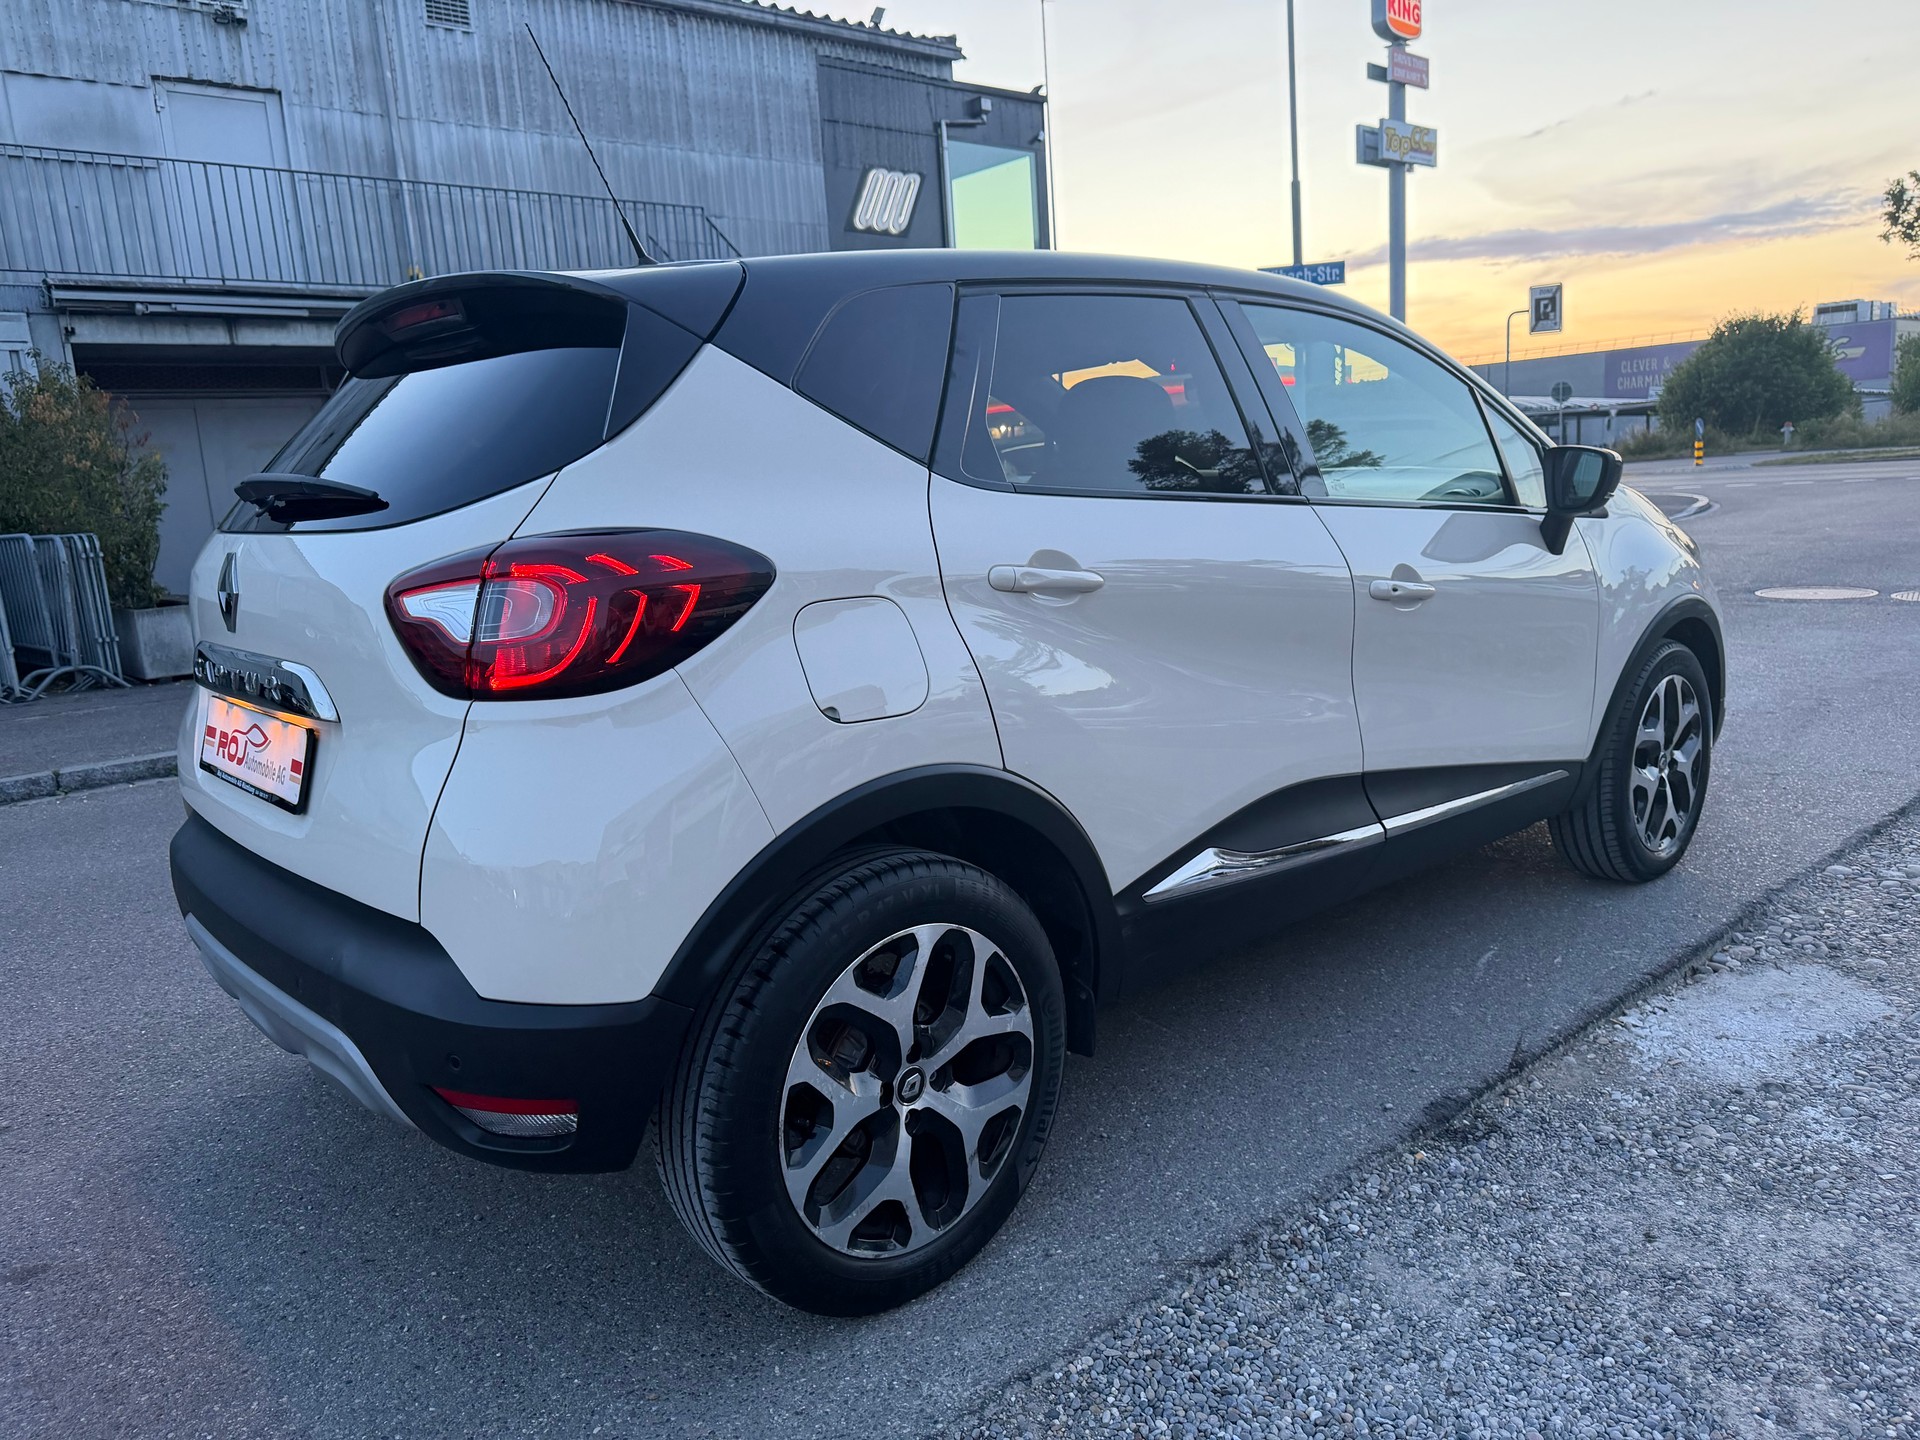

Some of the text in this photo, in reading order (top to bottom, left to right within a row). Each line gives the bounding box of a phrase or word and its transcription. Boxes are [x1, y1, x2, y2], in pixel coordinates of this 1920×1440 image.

[1388, 0, 1420, 24] KING
[1621, 356, 1671, 374] CLEVER &
[243, 752, 287, 785] Automobile AG
